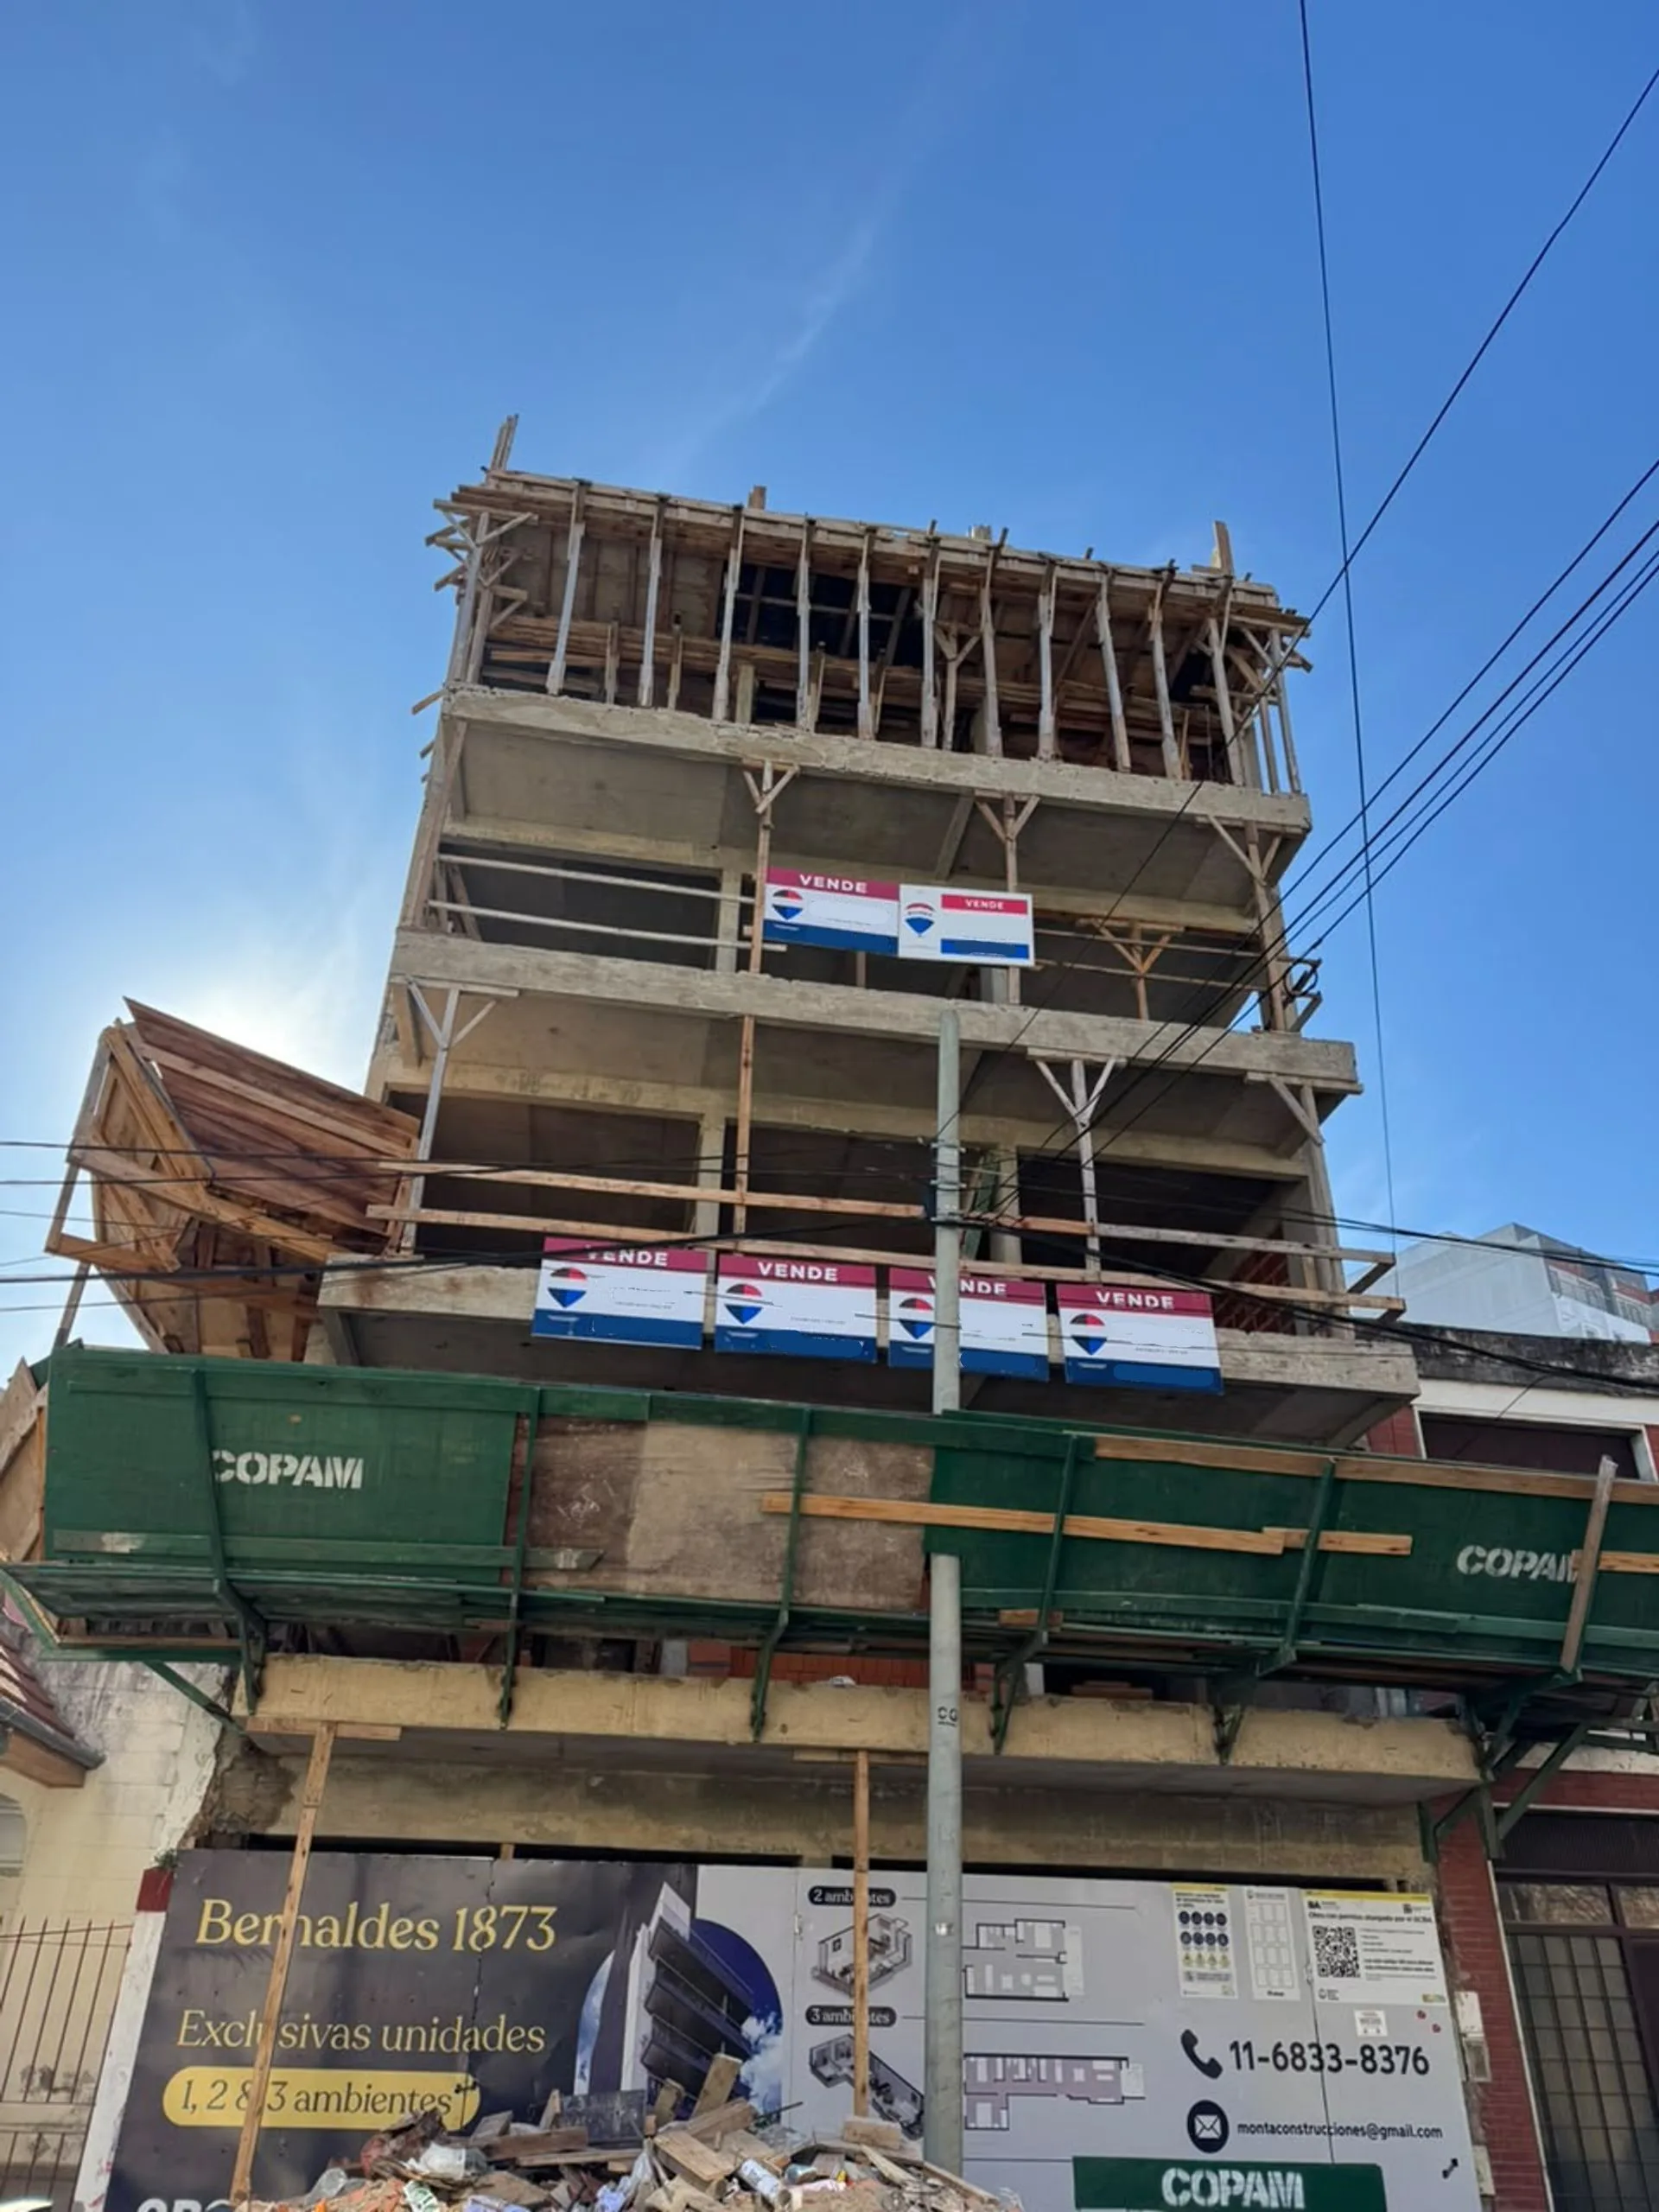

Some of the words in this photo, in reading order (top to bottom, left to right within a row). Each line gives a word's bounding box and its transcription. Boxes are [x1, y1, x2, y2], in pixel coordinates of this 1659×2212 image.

[799, 874, 868, 893] VENDE
[964, 899, 1004, 910] VENDE
[758, 1261, 838, 1282] VENDE
[928, 1275, 1007, 1295] NDE
[1096, 1291, 1173, 1310] VENDE
[213, 1449, 364, 1489] COPAM
[813, 1888, 823, 1903] 2
[452, 1904, 558, 1953] 1873
[810, 2007, 821, 2023] 3
[177, 2009, 372, 2052] Exclsivas
[382, 2013, 546, 2053] unidades
[1230, 2039, 1430, 2075] 11-6833-8376
[181, 2079, 197, 2115] 1,
[206, 2079, 228, 2110] 2
[267, 2081, 289, 2112] 3
[294, 2081, 453, 2115] ambientes
[1236, 2121, 1443, 2141] montaconstrucciones@gmail.com
[1161, 2167, 1306, 2209] COPAM
